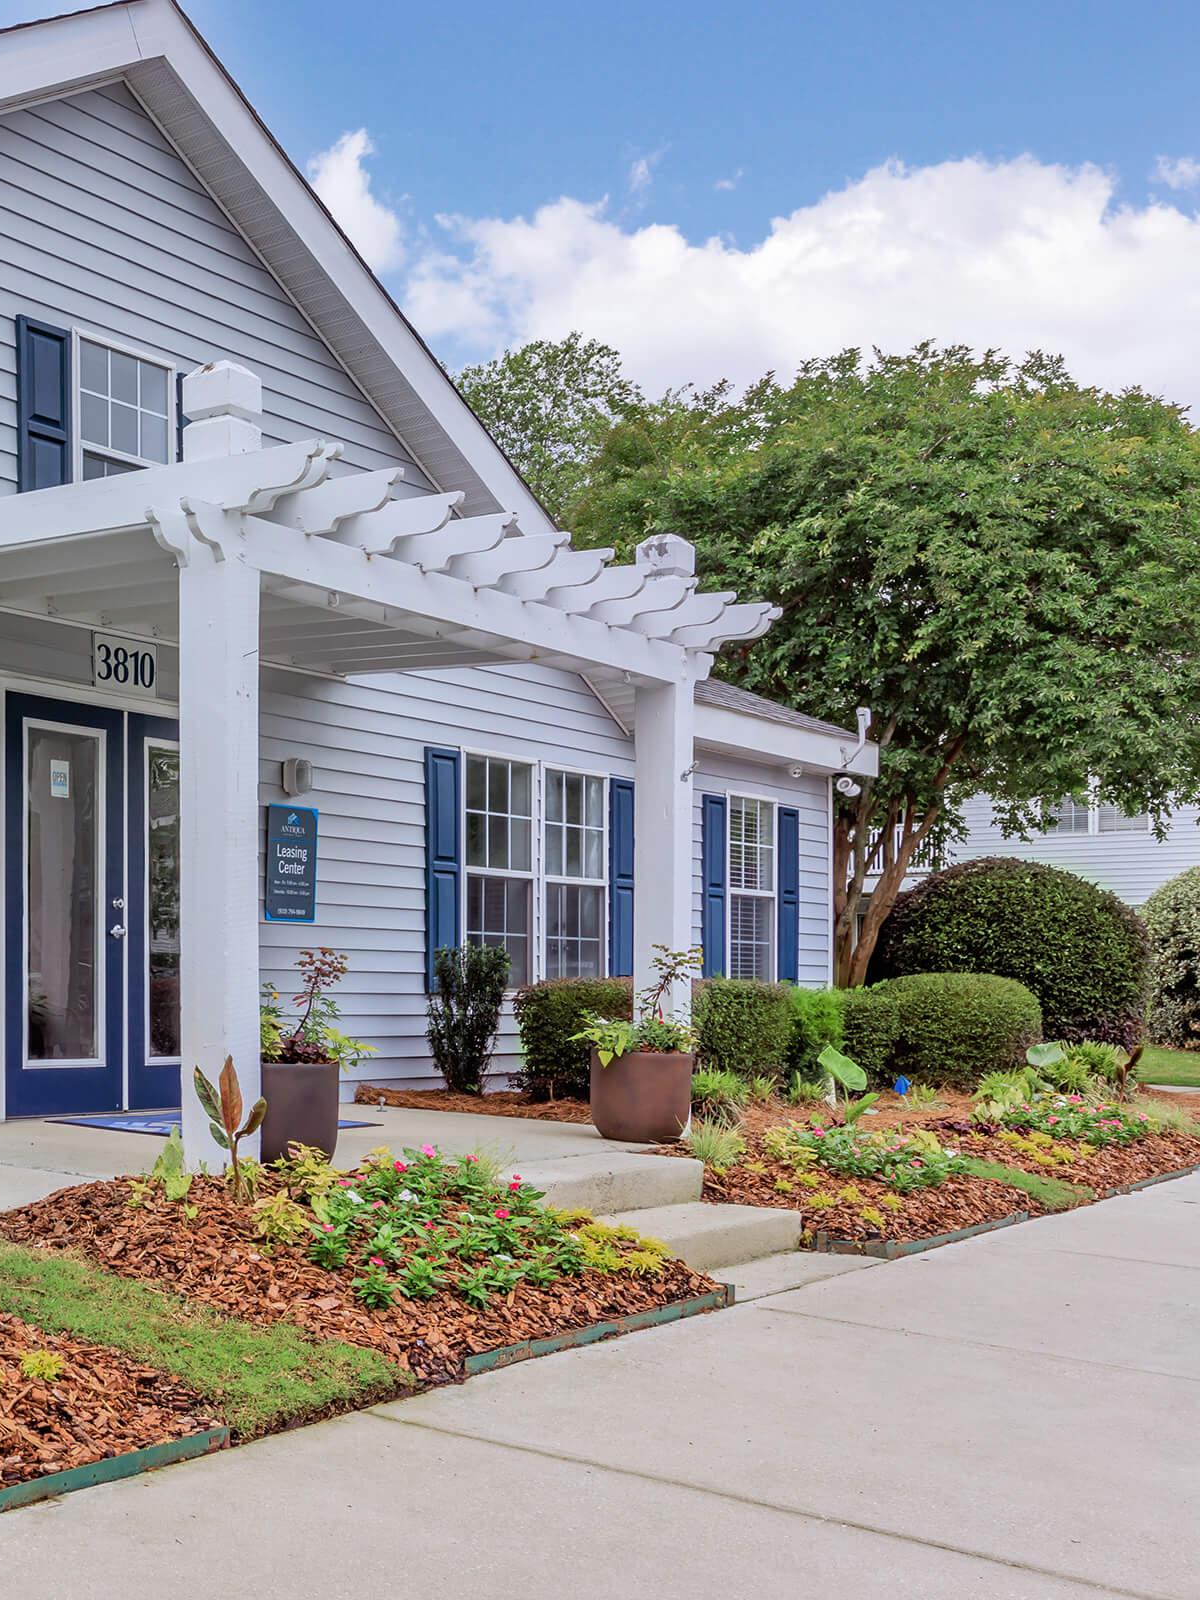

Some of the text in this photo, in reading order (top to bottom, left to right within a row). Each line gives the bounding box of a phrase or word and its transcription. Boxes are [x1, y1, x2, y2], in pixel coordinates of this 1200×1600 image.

[97, 644, 154, 688] 3810
[276, 843, 307, 862] Leasing
[278, 860, 304, 874] Center
